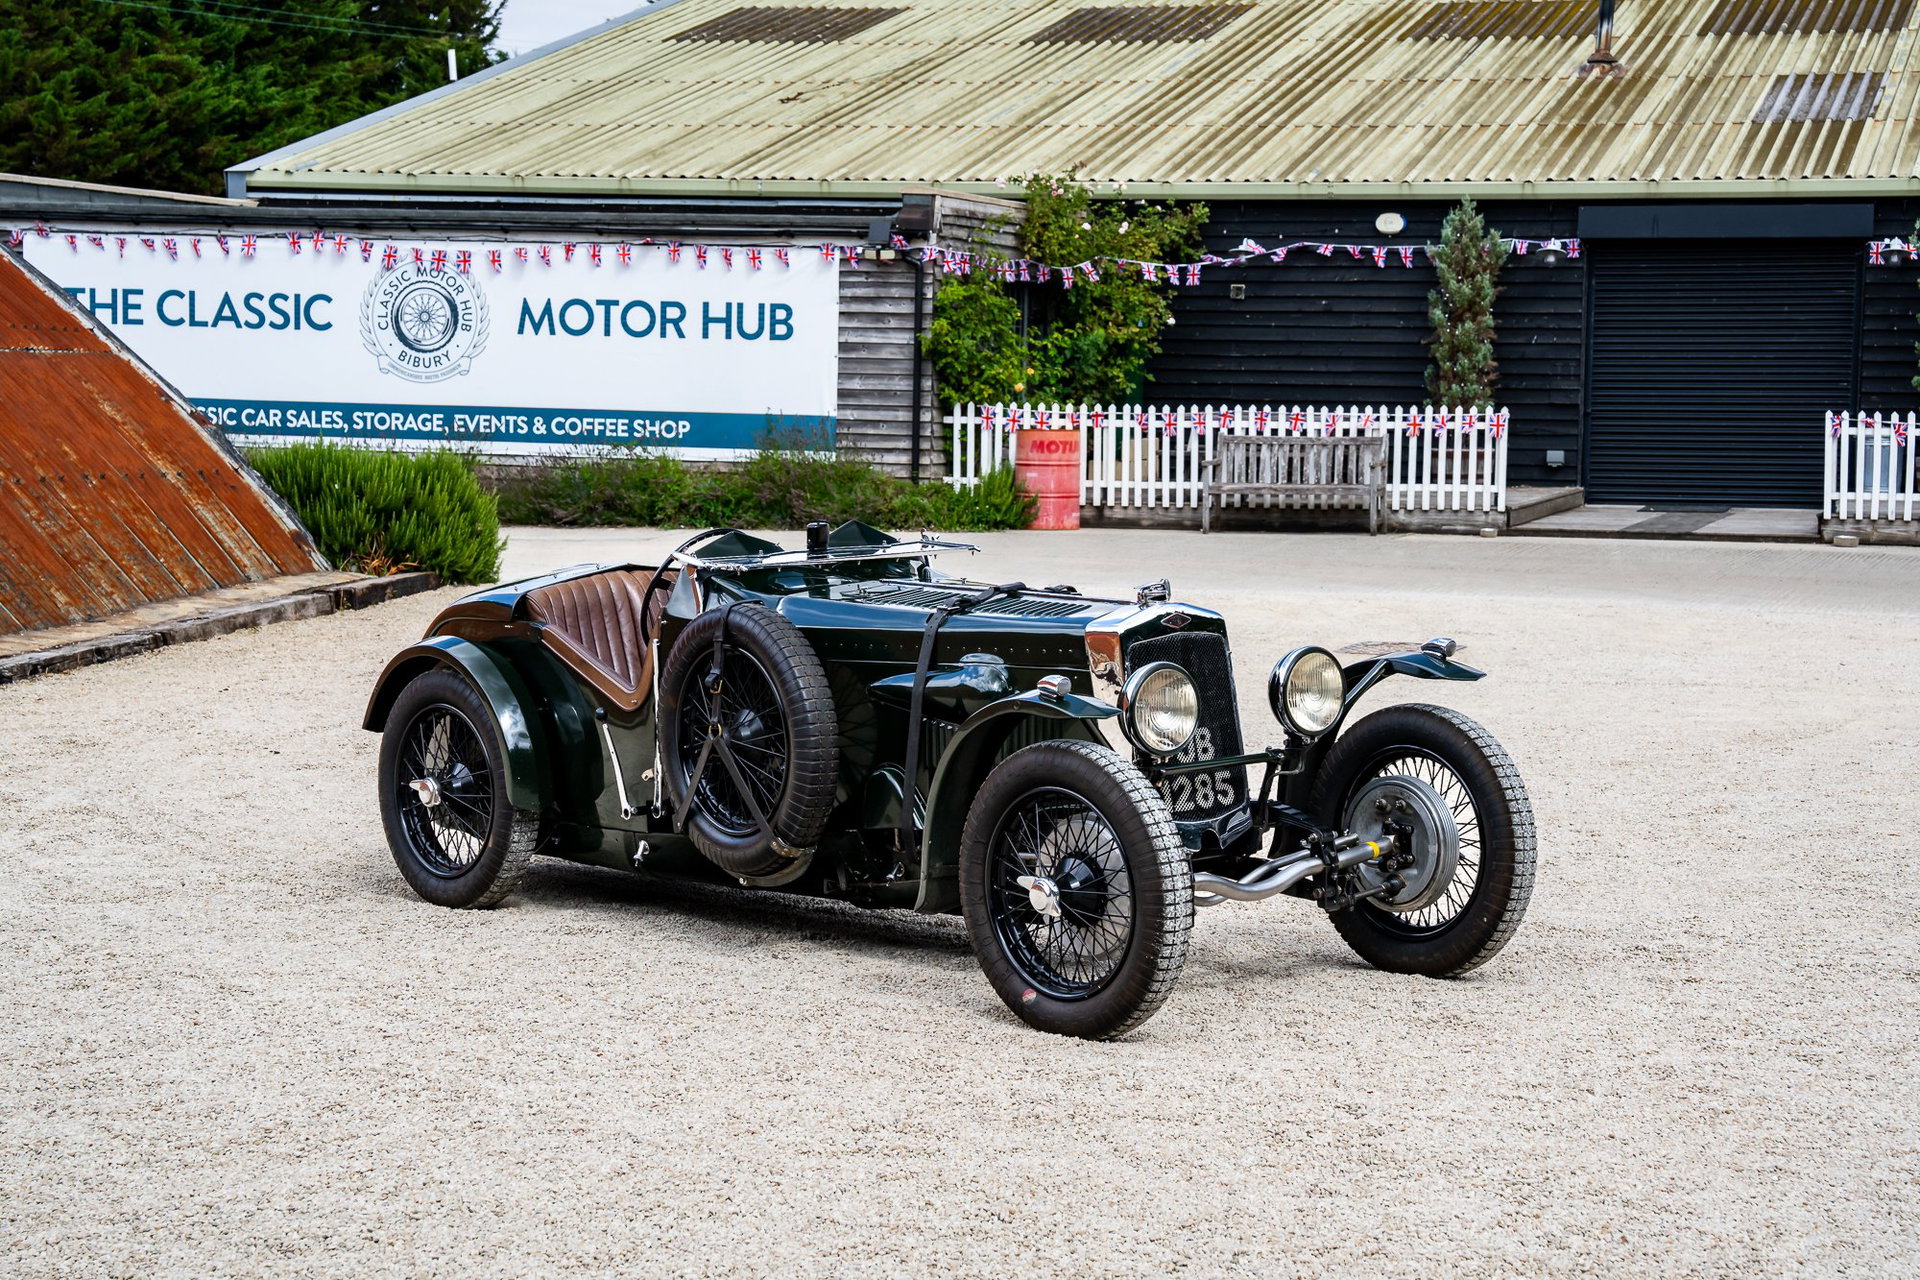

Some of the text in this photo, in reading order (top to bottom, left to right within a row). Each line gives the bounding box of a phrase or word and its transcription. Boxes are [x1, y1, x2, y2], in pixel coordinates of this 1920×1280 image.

[156, 289, 333, 331] CLASSIC
[517, 297, 686, 339] MOTOR
[702, 301, 794, 341] HUB
[377, 267, 473, 332] CLASSIC MOTOR HUB
[398, 350, 451, 368] BIBURY
[241, 409, 282, 426] CAR
[286, 410, 348, 433] SALES,
[352, 411, 449, 434] STORAGE,
[454, 414, 528, 434] EVENTS
[532, 416, 547, 435] &
[551, 416, 629, 437] COFFEE
[633, 418, 691, 439] SHOP
